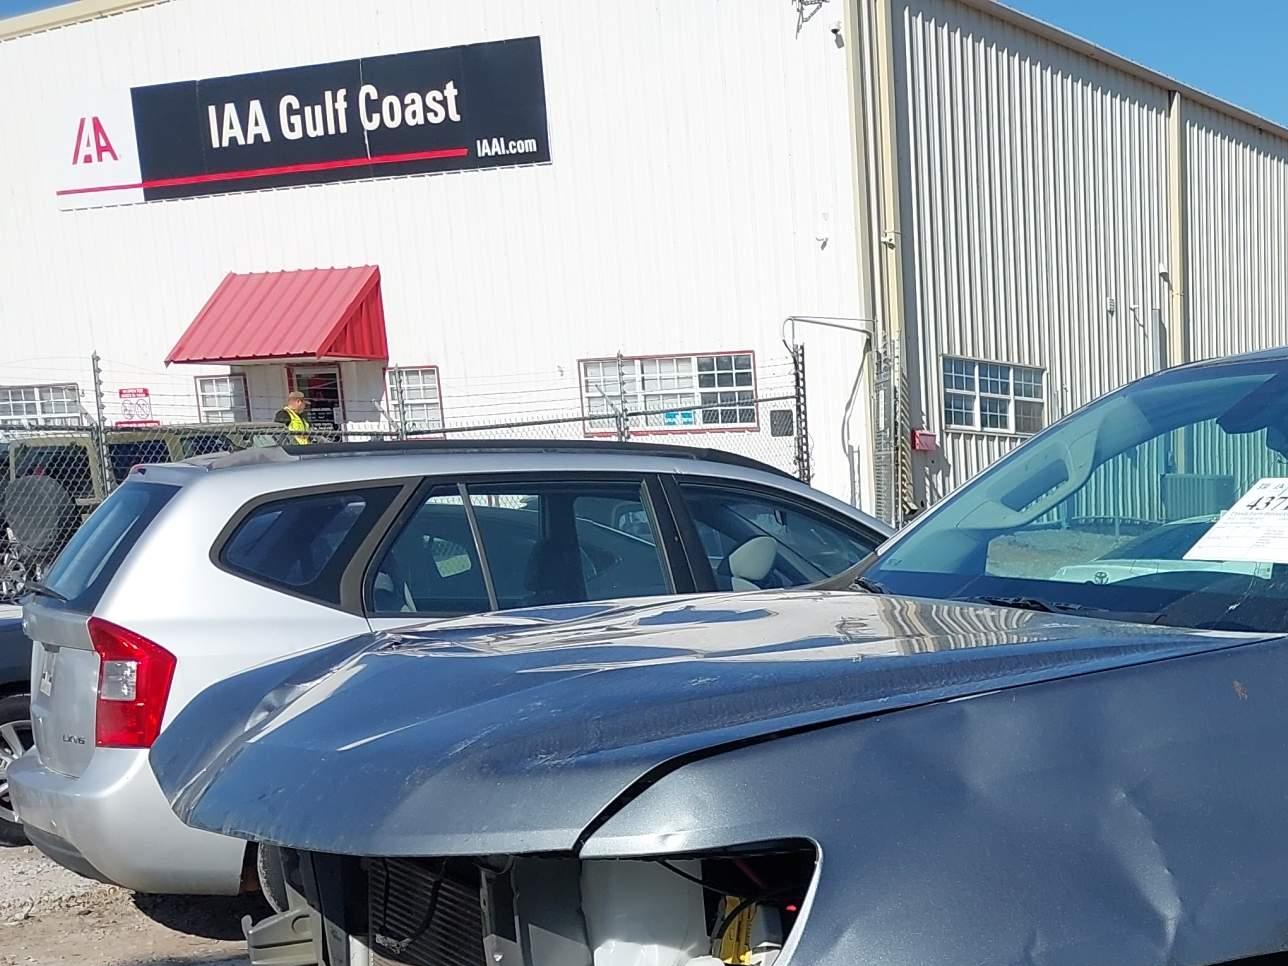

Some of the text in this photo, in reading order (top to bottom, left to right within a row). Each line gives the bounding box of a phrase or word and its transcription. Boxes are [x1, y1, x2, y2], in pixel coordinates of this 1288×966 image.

[207, 79, 462, 149] IAA Gulf Coast
[476, 137, 538, 157] IAAI.com
